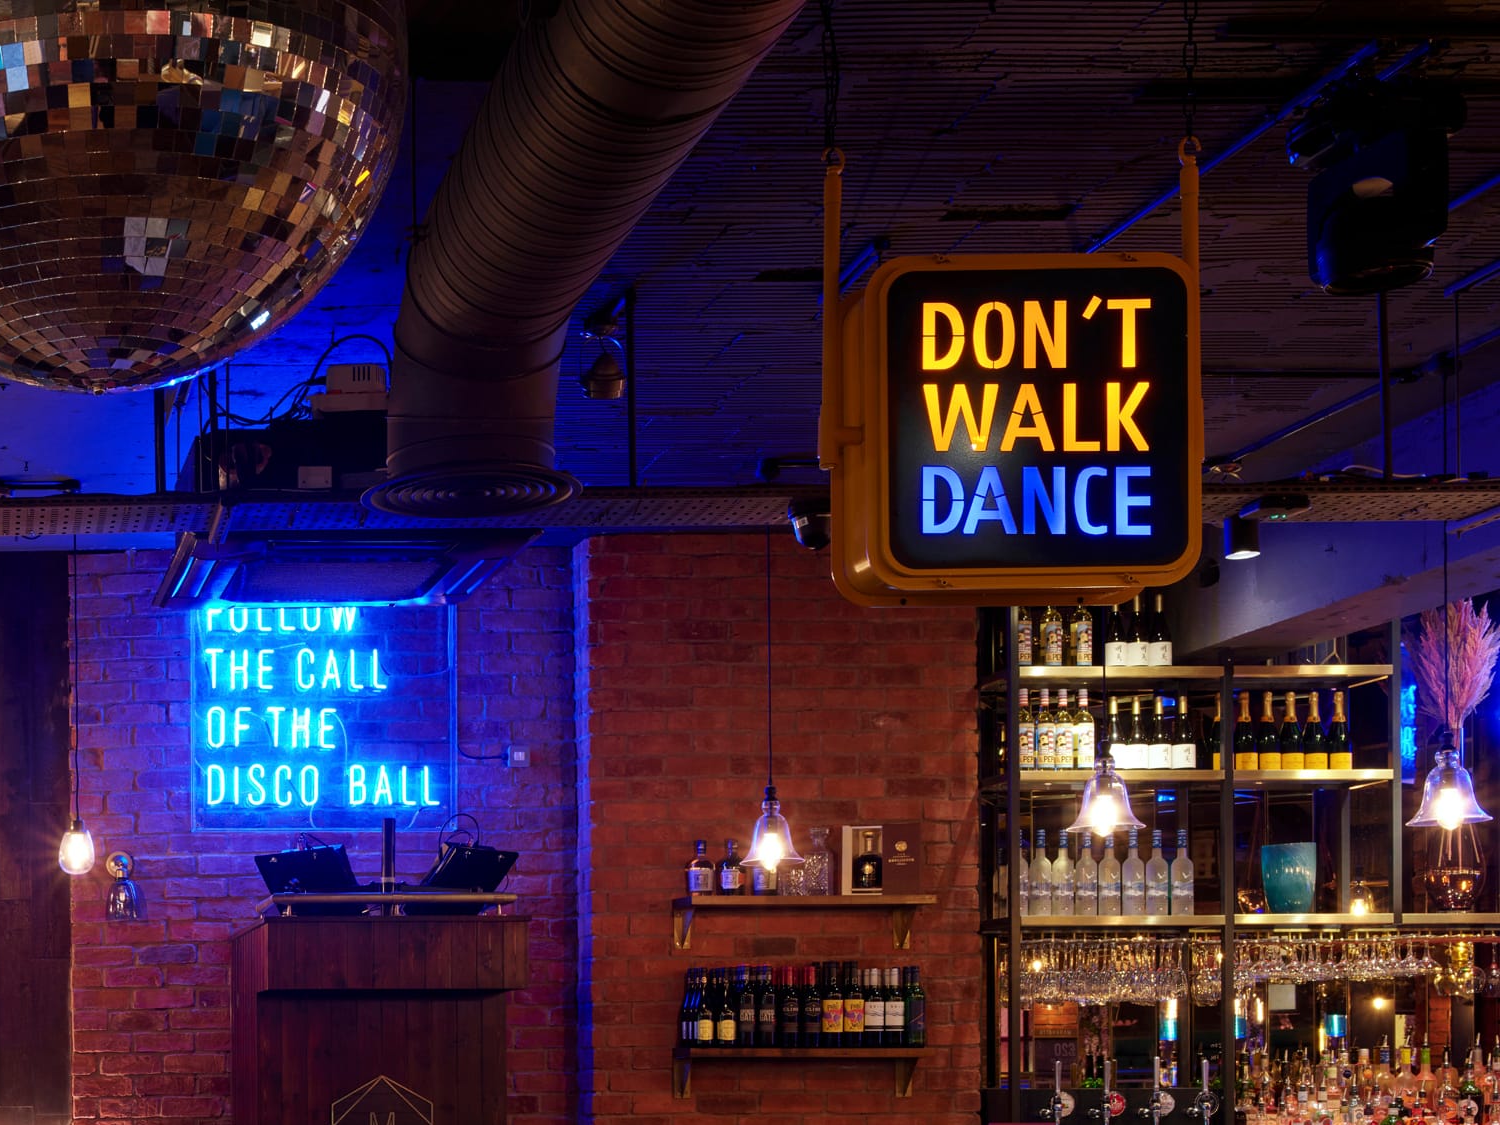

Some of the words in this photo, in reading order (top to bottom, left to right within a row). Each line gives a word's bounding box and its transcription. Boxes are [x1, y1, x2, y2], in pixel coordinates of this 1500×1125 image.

[921, 295, 1151, 371] DON'T
[923, 382, 1150, 453] WALK
[920, 465, 1151, 536] DANCE
[204, 648, 274, 690] THE
[295, 648, 387, 690] CALL
[206, 706, 252, 749] OF
[266, 706, 337, 749] THE
[206, 763, 319, 807] DISCO
[349, 764, 440, 806] BALL
